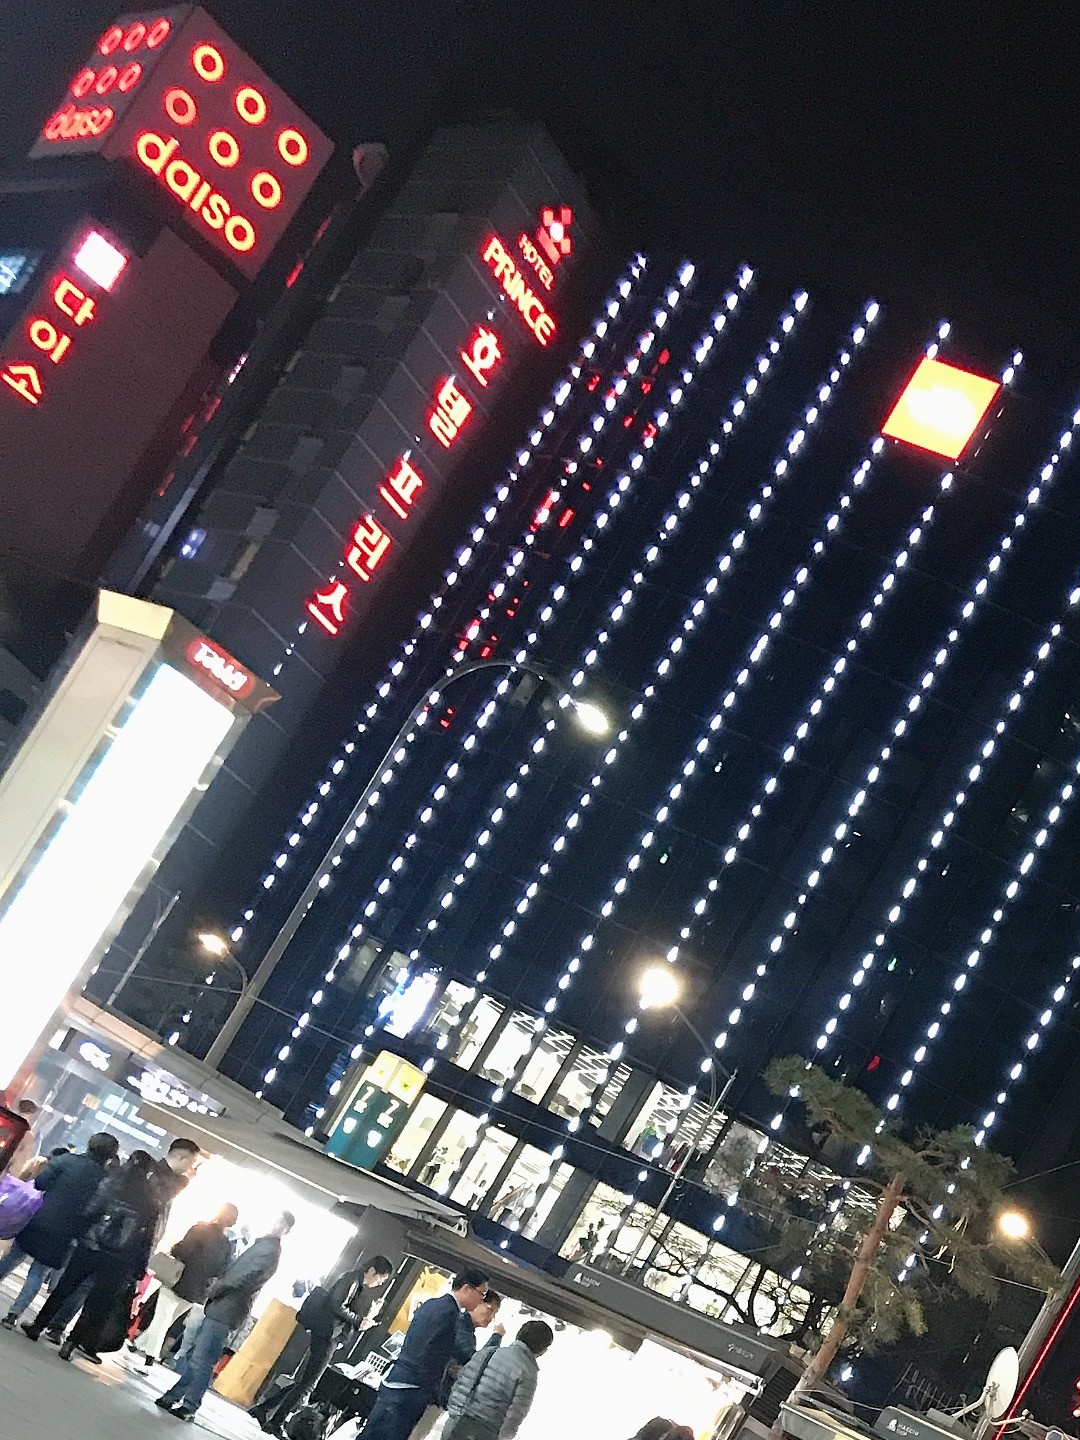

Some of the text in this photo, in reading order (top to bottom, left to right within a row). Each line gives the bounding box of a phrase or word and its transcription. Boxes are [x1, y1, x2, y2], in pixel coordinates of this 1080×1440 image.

[135, 131, 256, 253] daiso
[482, 234, 556, 346] PRINCE
[518, 234, 554, 290] HOTEL
[2, 278, 96, 405] 다이소
